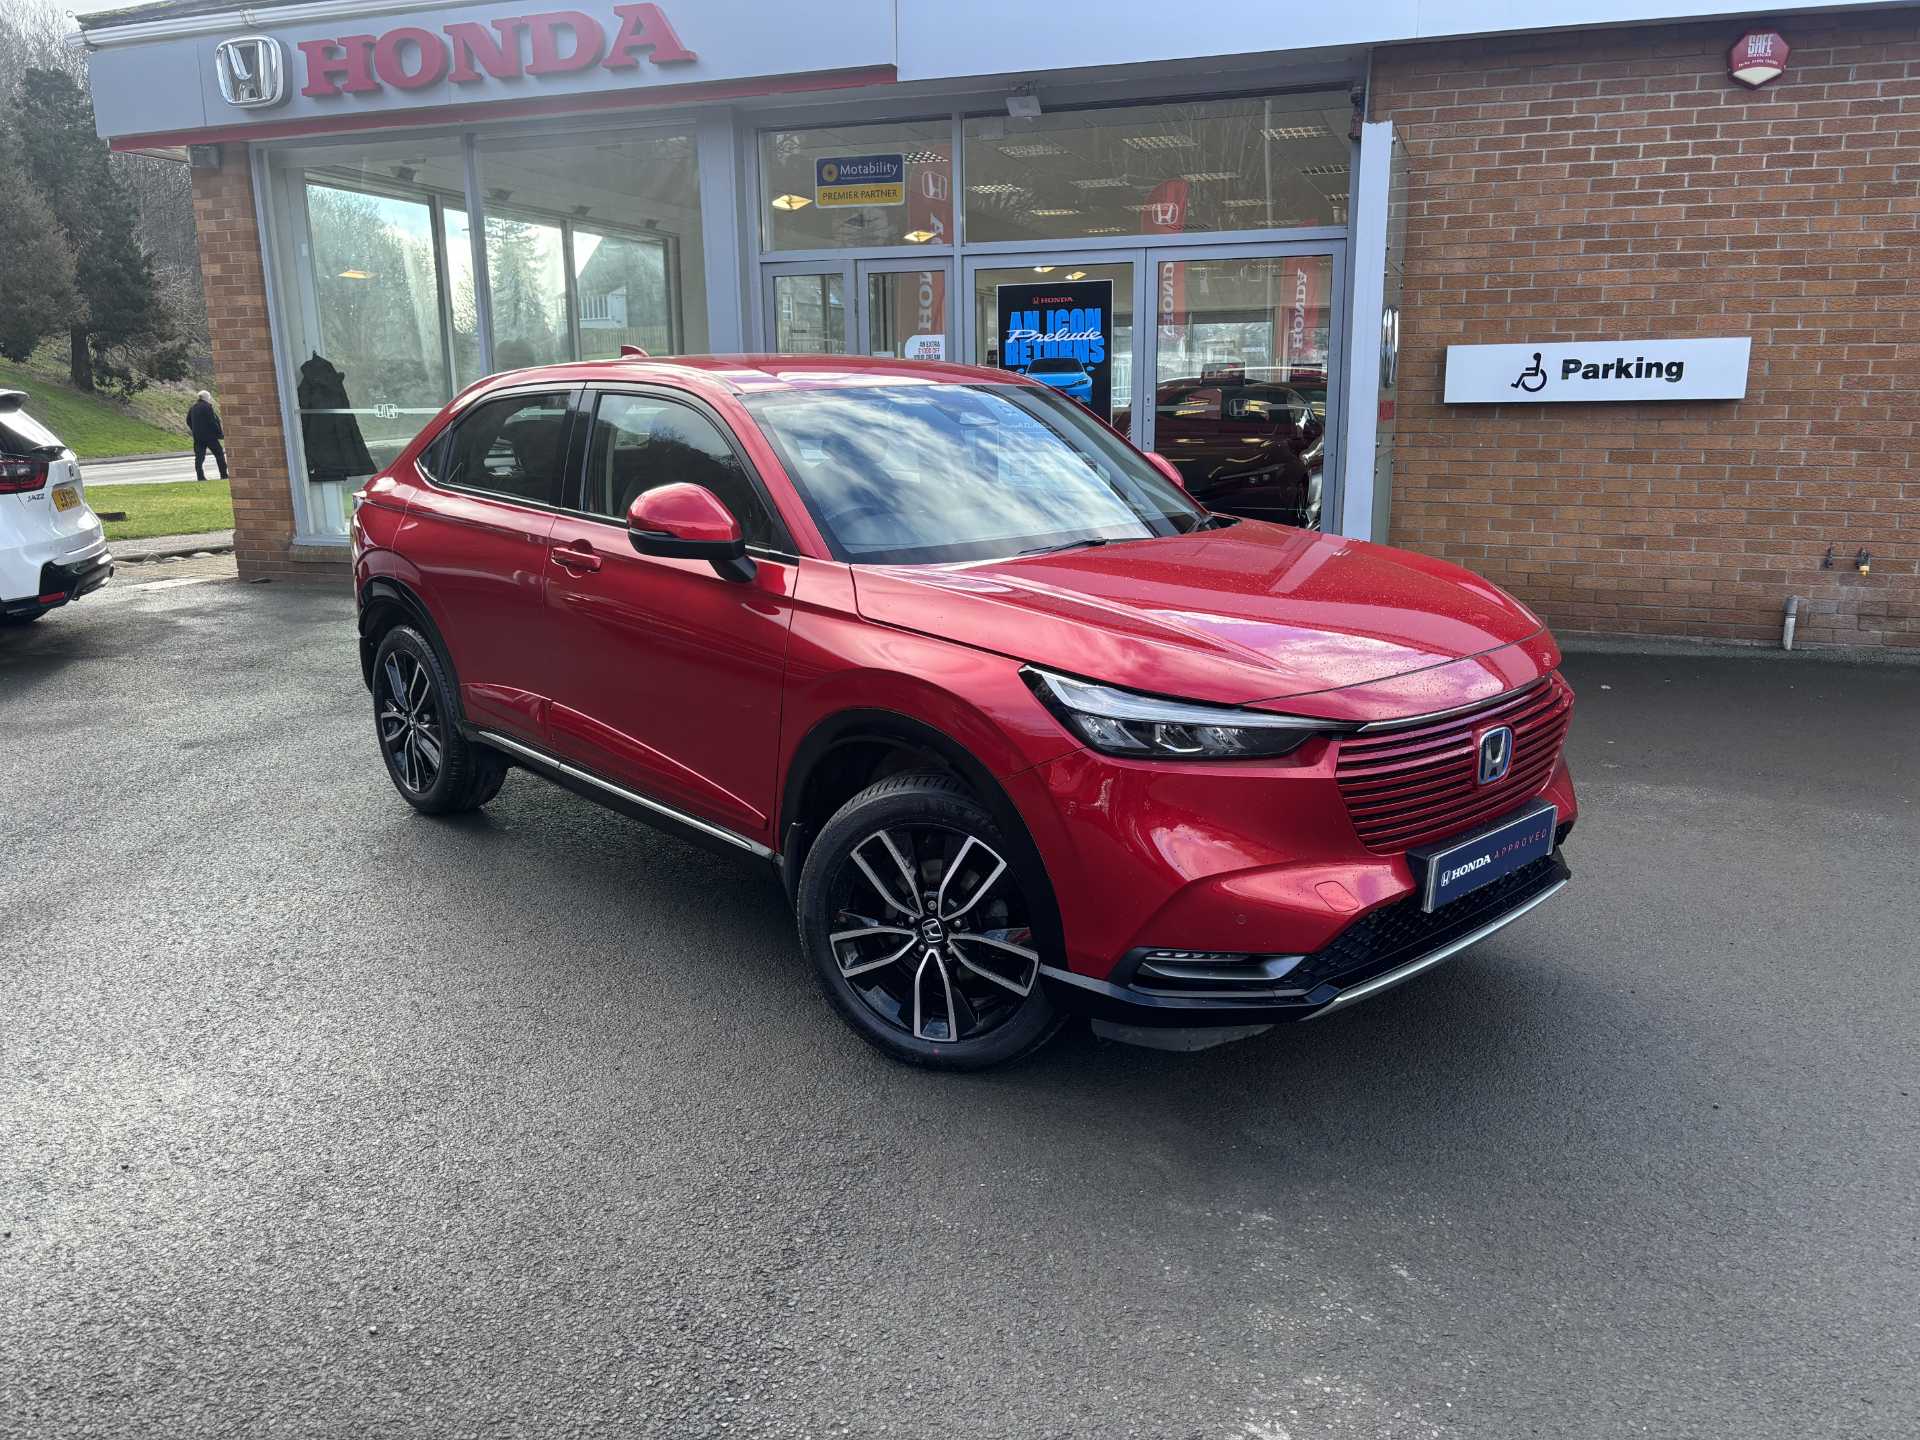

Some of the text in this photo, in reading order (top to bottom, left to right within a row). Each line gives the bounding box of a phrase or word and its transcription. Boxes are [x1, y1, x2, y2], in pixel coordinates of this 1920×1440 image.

[298, 3, 697, 97] HONDA
[840, 161, 898, 177] Motability
[822, 189, 897, 201] PREMIER PARTNER
[1007, 327, 1103, 344] Prelude
[1009, 308, 1102, 338] AN ICON
[1561, 357, 1684, 383] Parking
[1451, 830, 1547, 880] HONDA APPROVED
